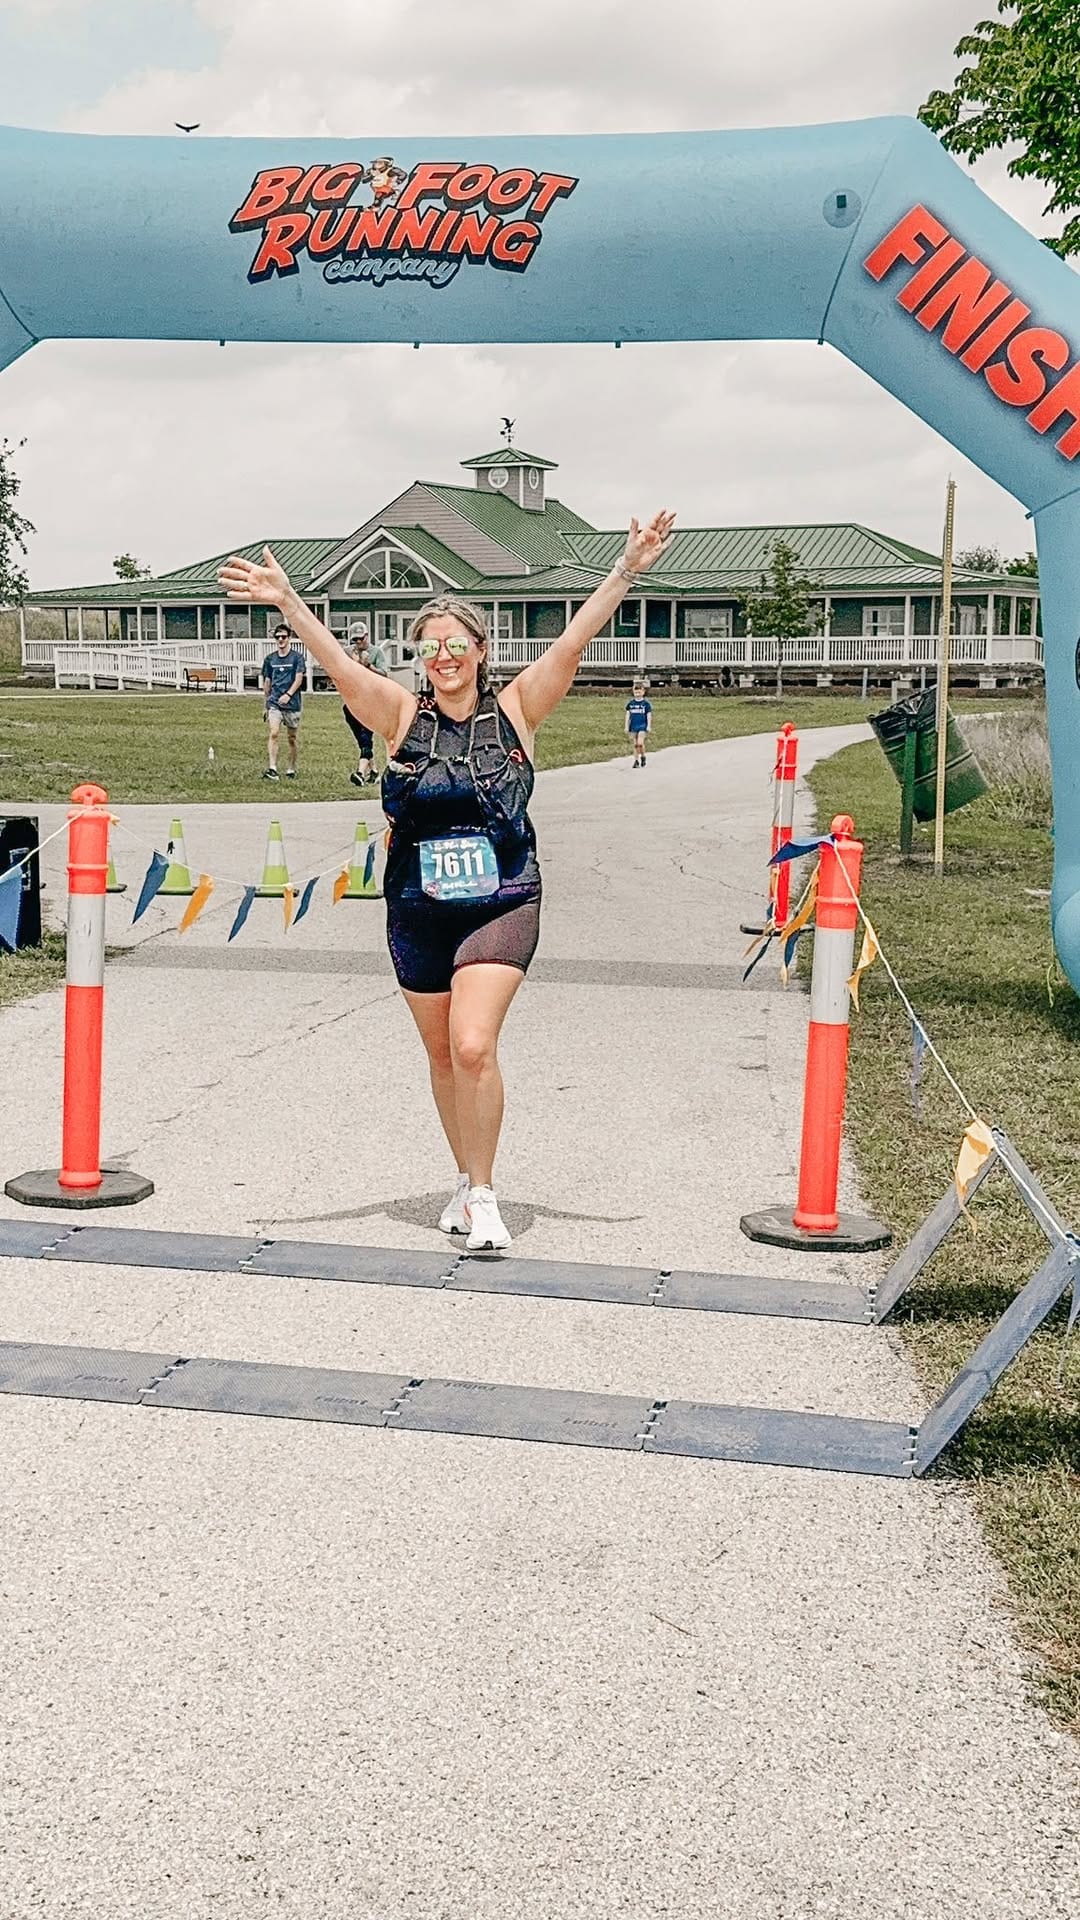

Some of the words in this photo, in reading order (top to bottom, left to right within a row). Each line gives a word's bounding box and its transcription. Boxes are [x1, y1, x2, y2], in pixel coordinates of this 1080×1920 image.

[229, 163, 364, 233] BIG
[395, 163, 579, 222] FOOT
[248, 205, 542, 284] RUNNING
[323, 257, 459, 289] company
[431, 849, 485, 879] 7611
